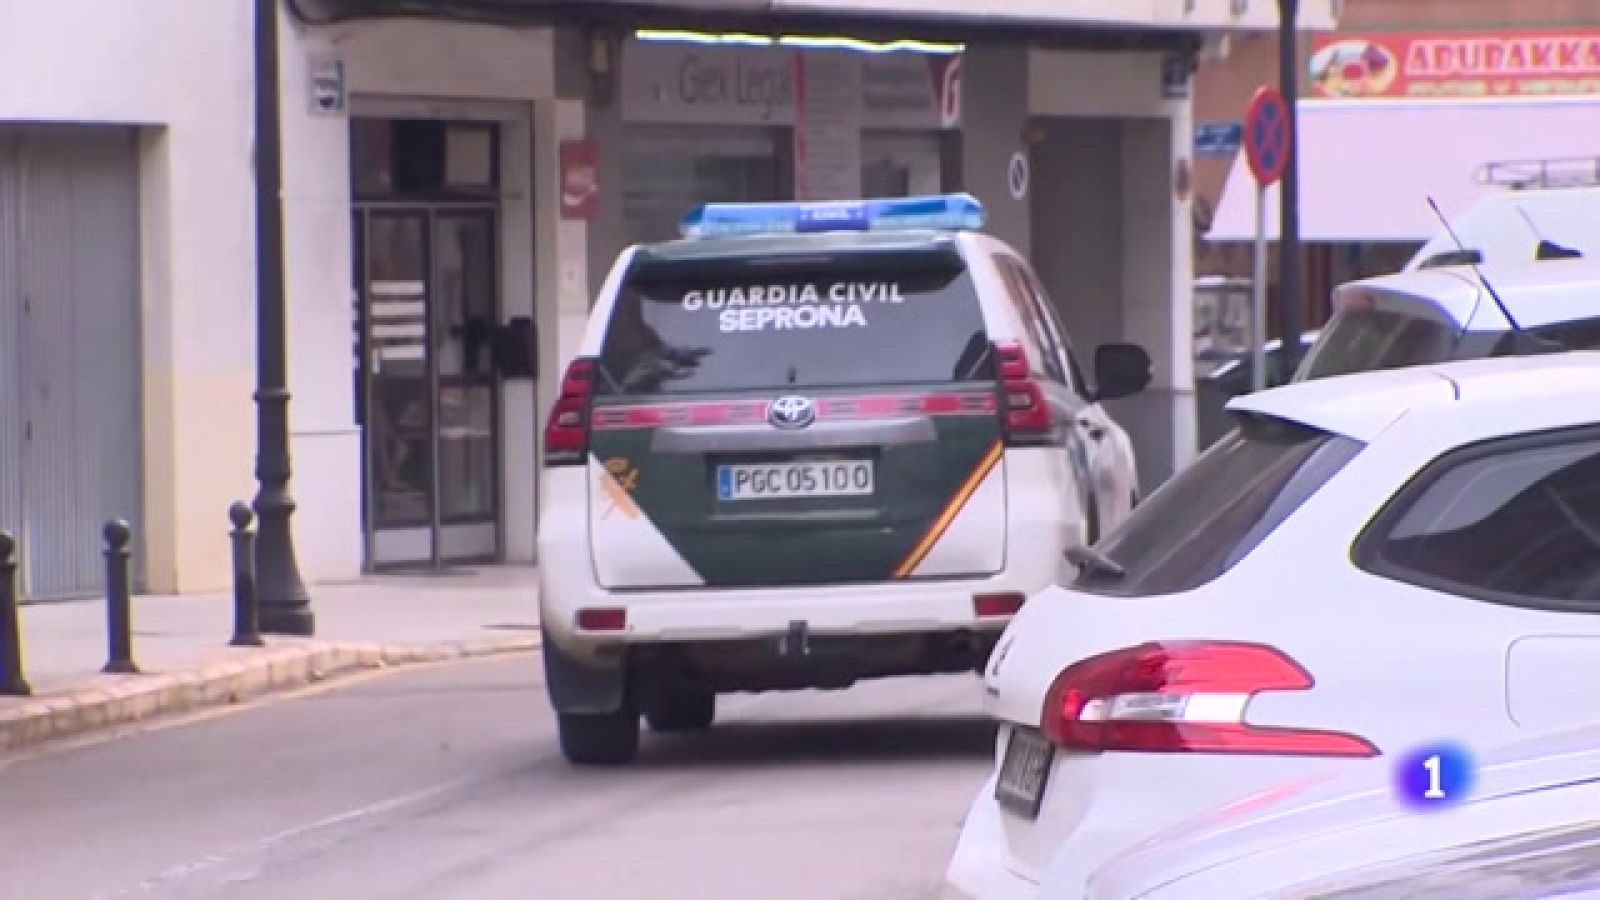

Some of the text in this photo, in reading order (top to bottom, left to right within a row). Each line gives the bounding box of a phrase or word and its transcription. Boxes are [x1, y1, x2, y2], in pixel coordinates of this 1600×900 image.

[683, 282, 905, 311] GUARDIA CIVIL
[719, 304, 868, 333] SEPRONA
[735, 468, 781, 493] PGC
